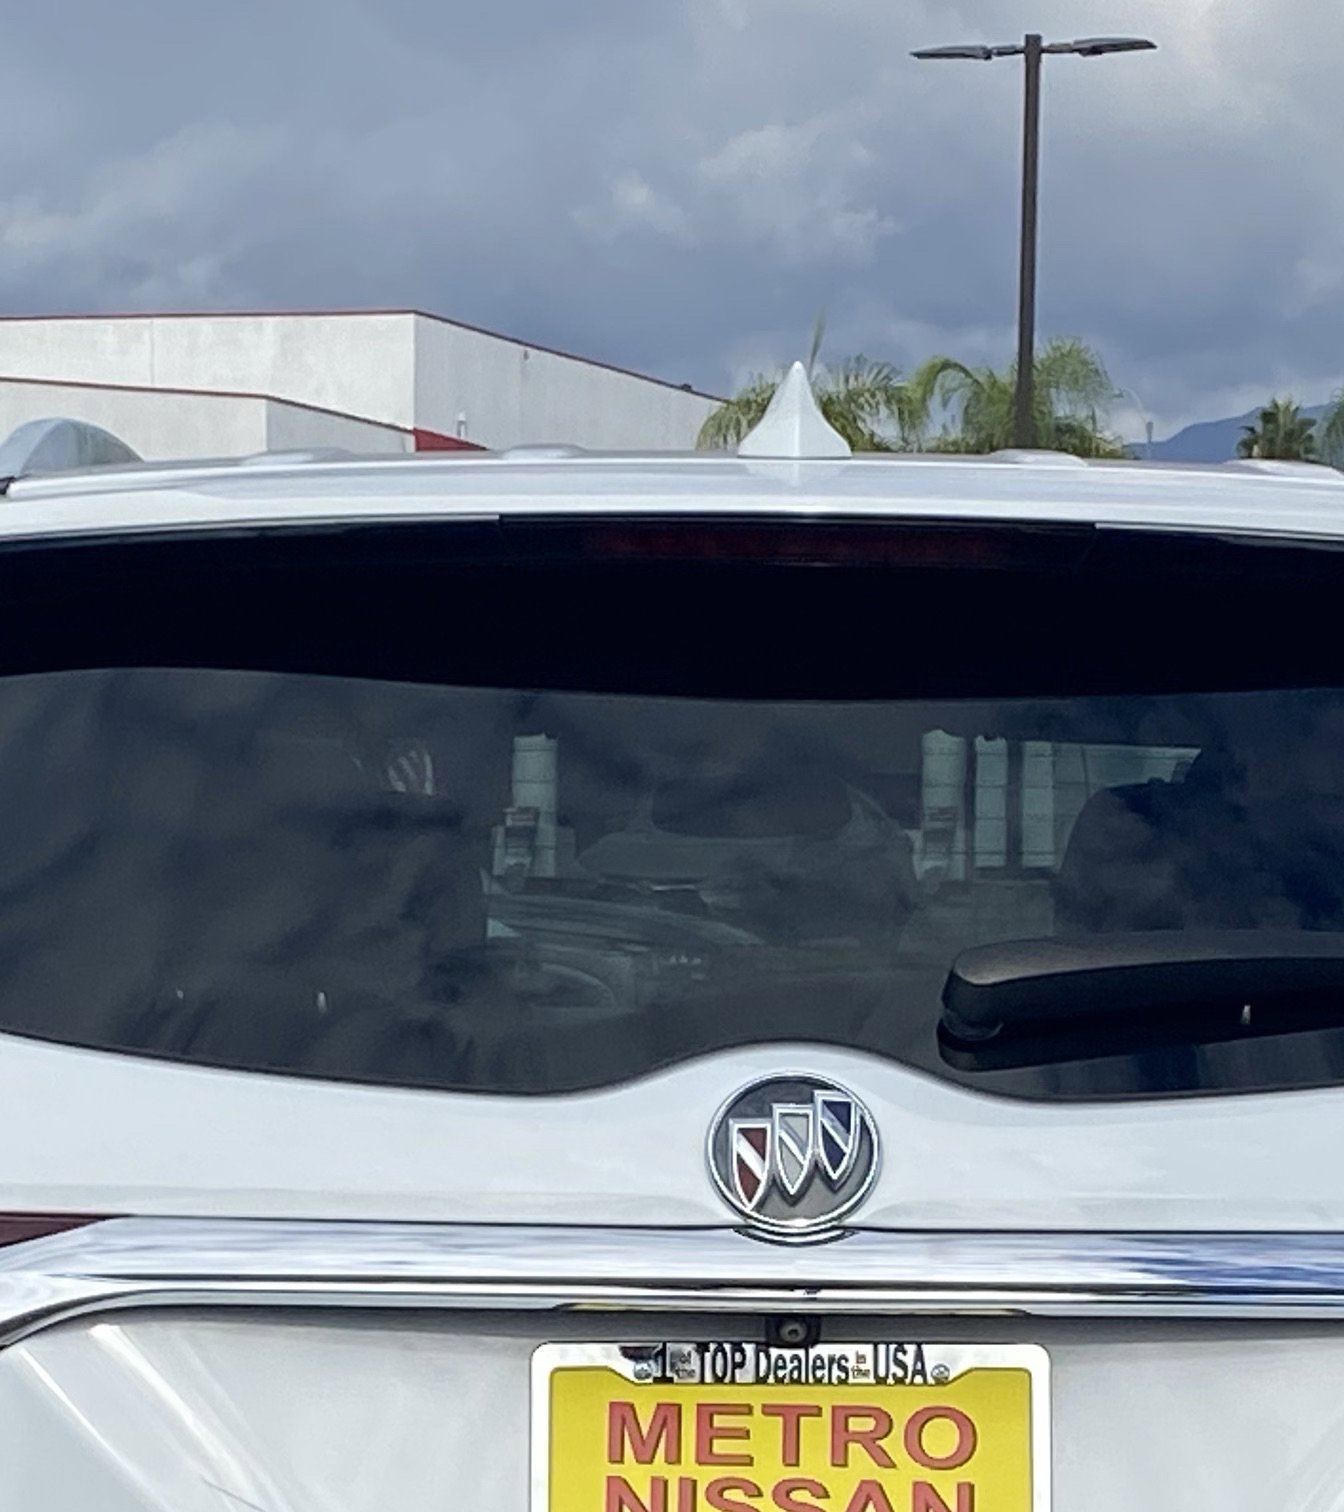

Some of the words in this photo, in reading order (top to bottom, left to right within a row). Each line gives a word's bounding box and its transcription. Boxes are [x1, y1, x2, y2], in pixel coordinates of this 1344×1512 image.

[696, 1341, 747, 1384] TOP
[756, 1342, 850, 1385] Dealers
[873, 1342, 929, 1386] USA
[607, 1400, 978, 1471] METRO
